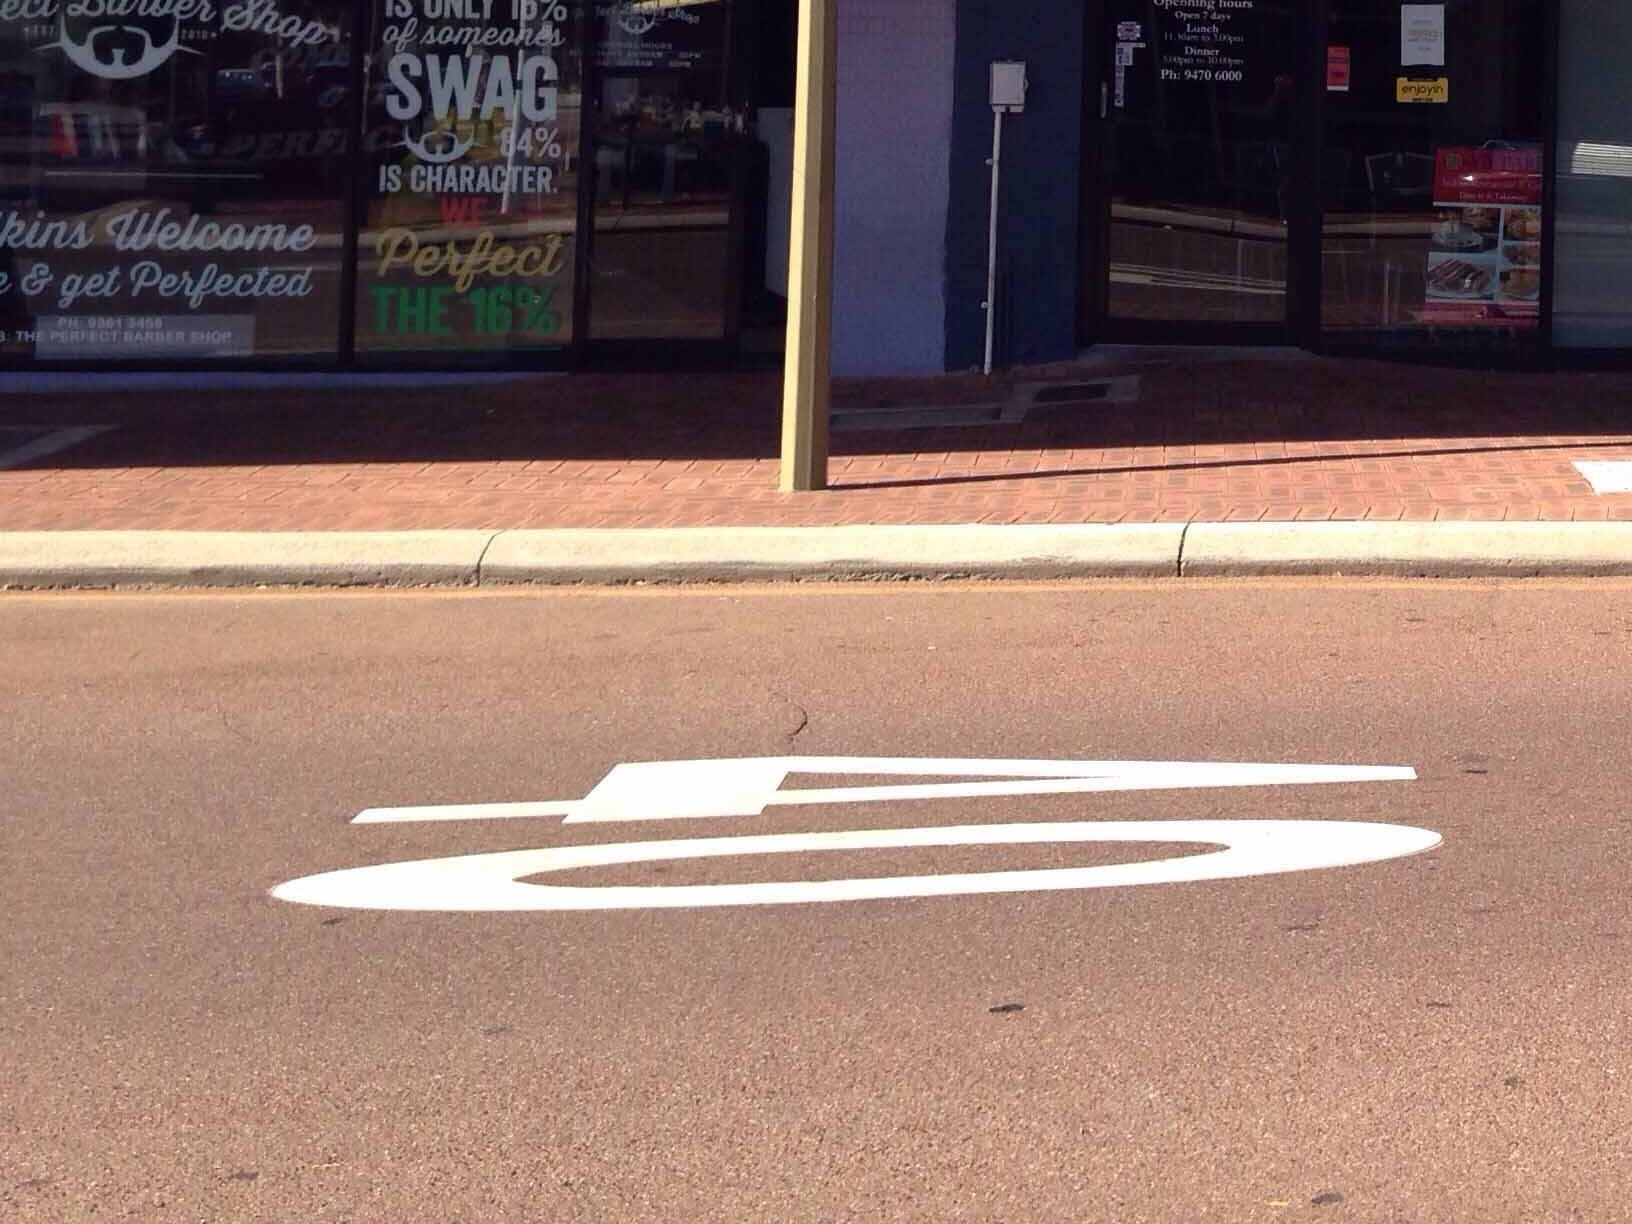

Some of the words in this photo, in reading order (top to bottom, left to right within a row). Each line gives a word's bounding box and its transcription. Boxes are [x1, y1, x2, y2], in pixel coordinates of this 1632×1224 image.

[383, 17, 418, 53] of
[1186, 23, 1219, 33] Lunch
[1185, 46, 1220, 56] Dinner
[386, 54, 558, 121] SWAG
[1184, 69, 1211, 81] 9470
[1215, 70, 1242, 81] 6000
[379, 165, 402, 192] IS
[106, 208, 318, 251] Welcome
[441, 196, 482, 227] WE
[376, 226, 563, 293] Perfect
[20, 262, 54, 297] &
[57, 266, 121, 310] get
[129, 260, 313, 310] Perfected
[374, 284, 450, 334] THE
[469, 285, 559, 334] 16%
